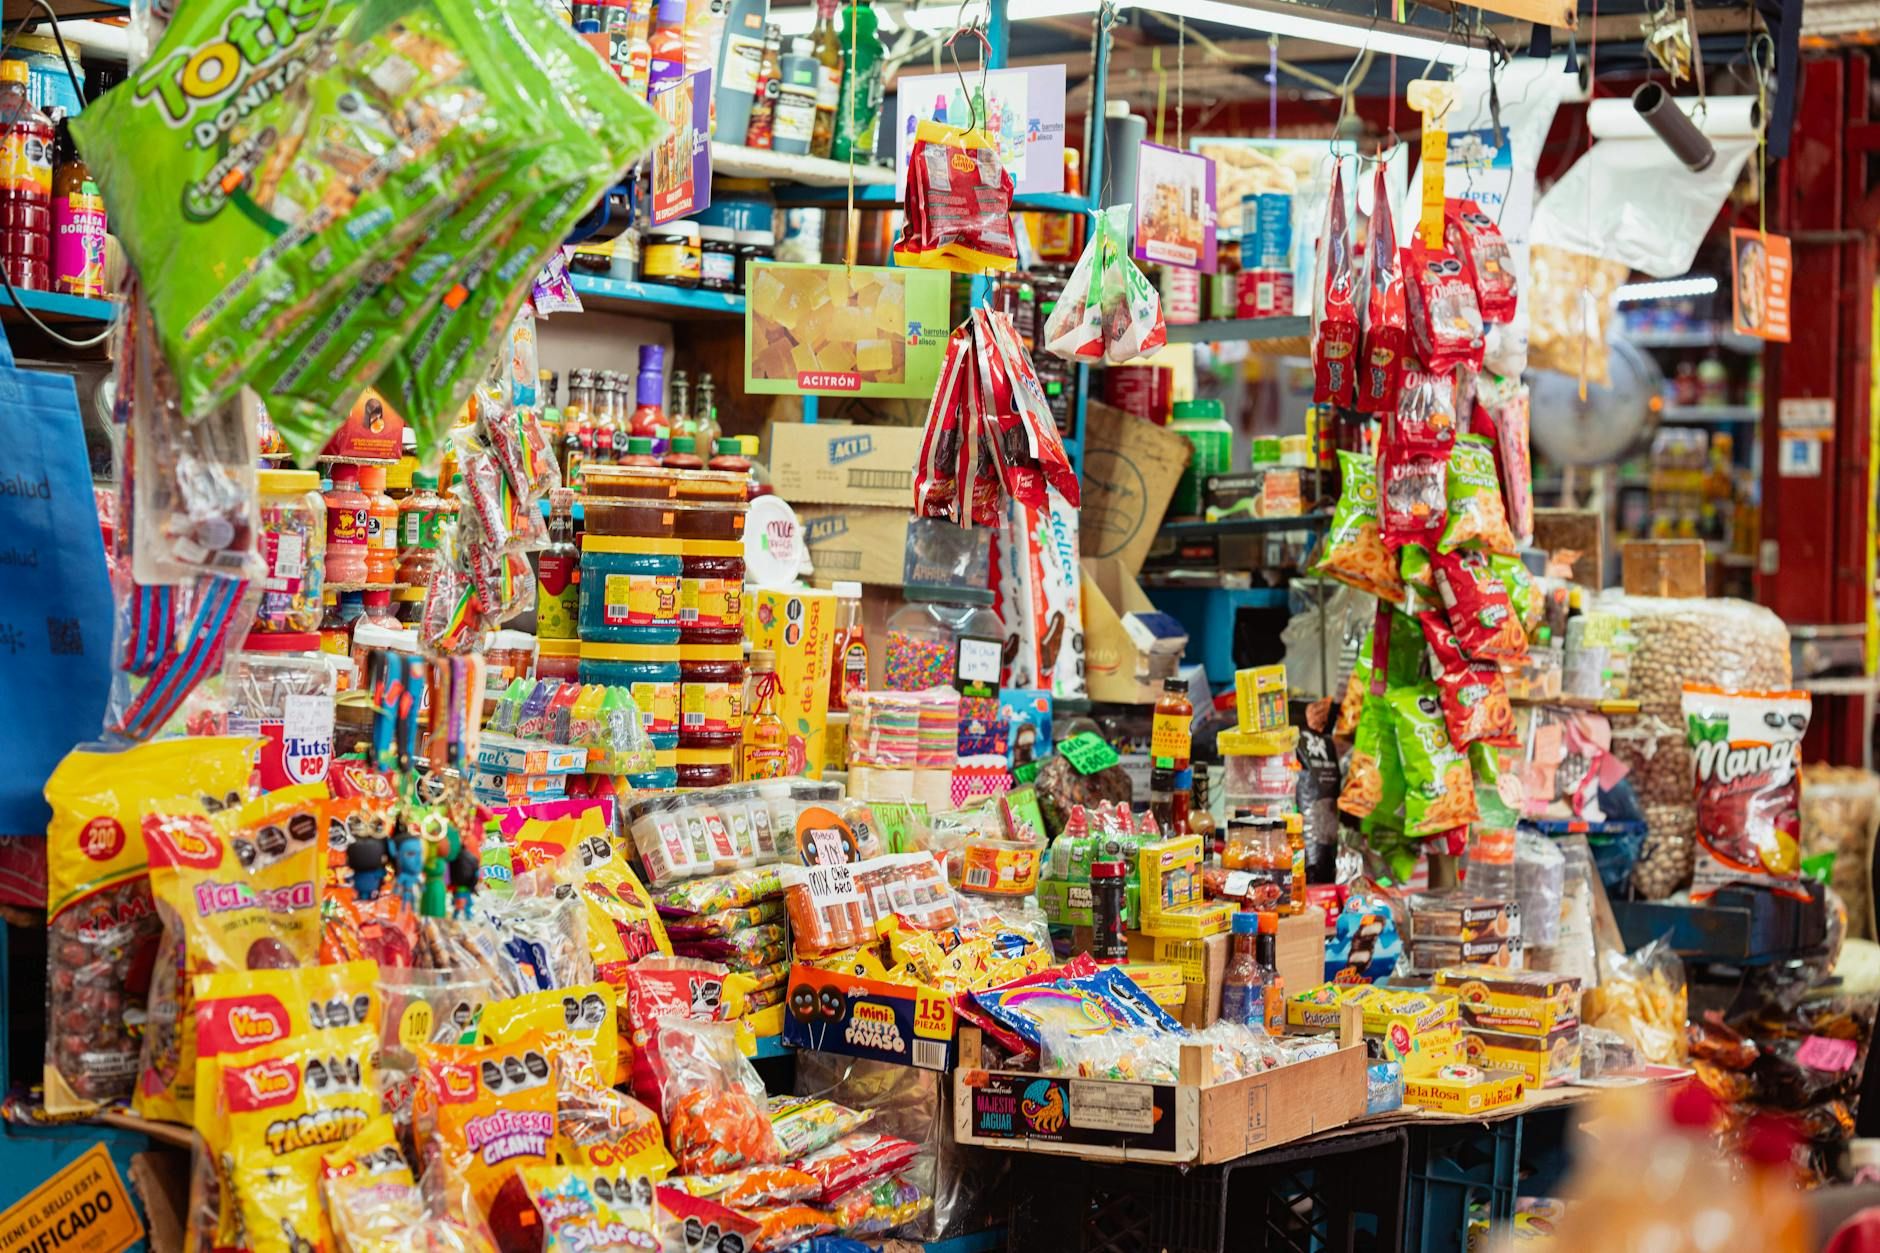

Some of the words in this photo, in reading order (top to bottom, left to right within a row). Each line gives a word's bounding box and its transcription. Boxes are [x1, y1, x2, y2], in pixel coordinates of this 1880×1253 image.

[1460, 192, 1503, 205] OPEN
[73, 214, 103, 226] SALSA
[907, 335, 937, 346] Jalisco
[803, 375, 855, 387] ACITRÓN
[0, 547, 38, 568] alud
[804, 600, 821, 657] Rosa
[803, 662, 815, 682] la
[801, 684, 813, 713] de
[285, 736, 331, 757] Tutsi
[300, 757, 324, 776] POP
[477, 751, 510, 766] nel's
[87, 828, 117, 850] 200
[808, 867, 832, 897] MIX
[831, 864, 850, 882] Chile
[858, 1006, 890, 1022] Mini
[918, 998, 946, 1022] 15
[1304, 1009, 1341, 1029] Pulparin
[232, 1010, 275, 1037] Vero
[408, 1011, 430, 1037] 100
[850, 1017, 900, 1038] PALETA
[914, 1020, 947, 1032] PIEZAS
[844, 1028, 905, 1054] PAYASO
[1417, 1085, 1428, 1098] la
[1430, 1086, 1460, 1101] Rosa
[1483, 1093, 1491, 1106] de
[1491, 1092, 1497, 1105] la
[1497, 1089, 1513, 1103] Rosa
[977, 1095, 1017, 1115] MAJESTIC
[464, 1109, 553, 1153] PicaFresa
[980, 1113, 1012, 1131] JAGUAR
[483, 1132, 547, 1166] GIGANTE
[28, 1213, 42, 1229] EL
[42, 1190, 74, 1219] SELLO
[560, 1218, 655, 1251] Sabores
